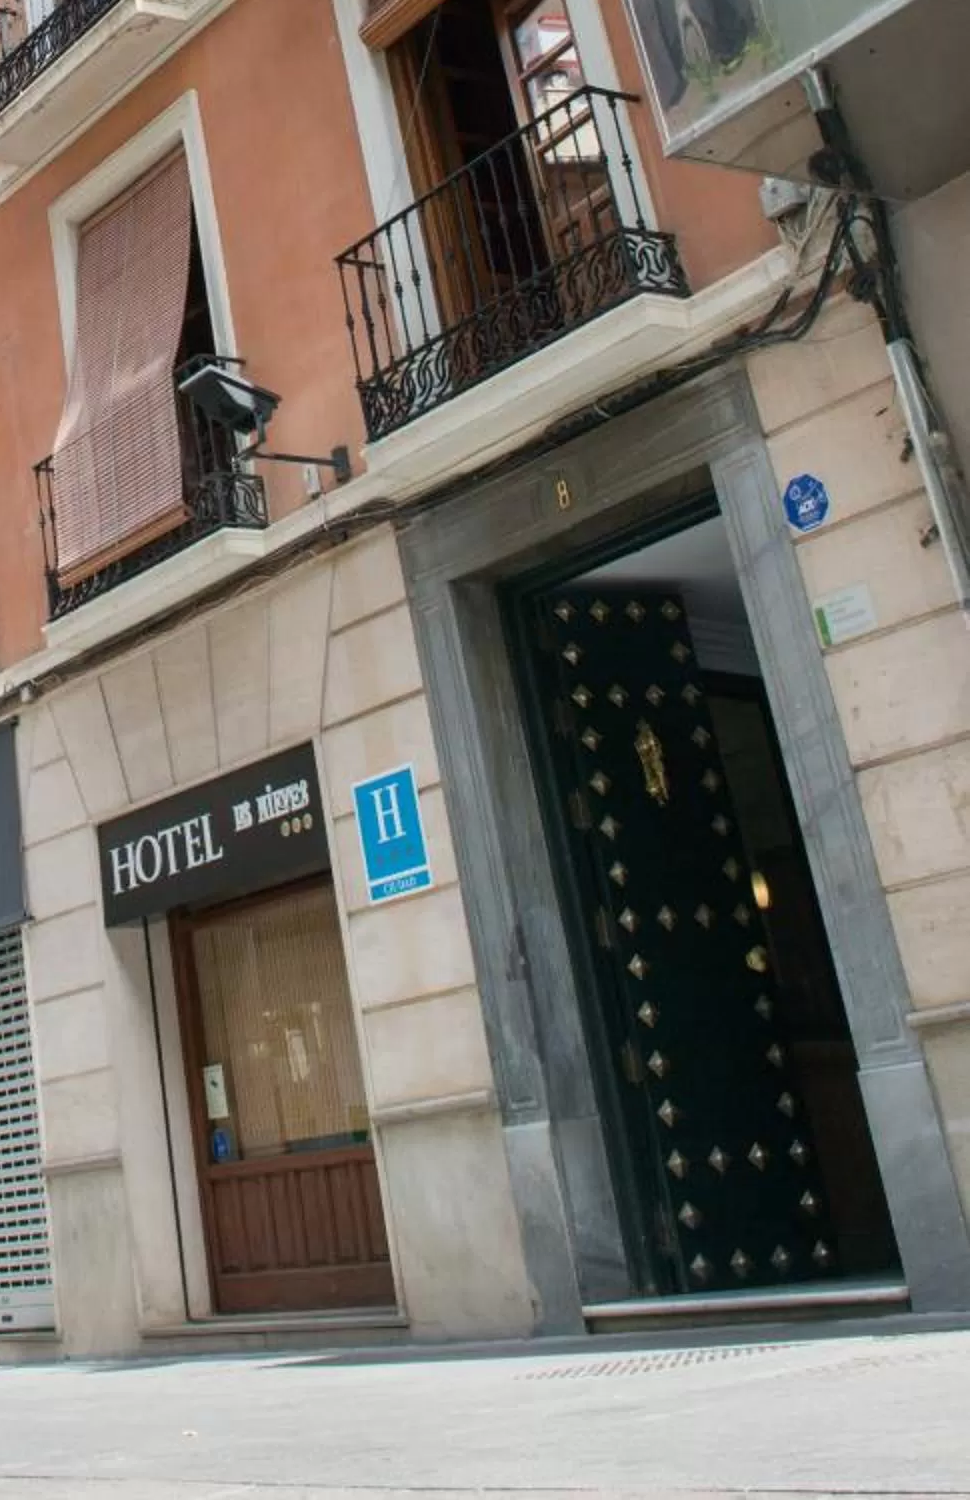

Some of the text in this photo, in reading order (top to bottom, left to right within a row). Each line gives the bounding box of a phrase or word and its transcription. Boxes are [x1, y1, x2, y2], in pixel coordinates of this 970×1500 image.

[556, 478, 571, 509] 8
[369, 782, 407, 845] H
[109, 813, 224, 896] HOTEL
